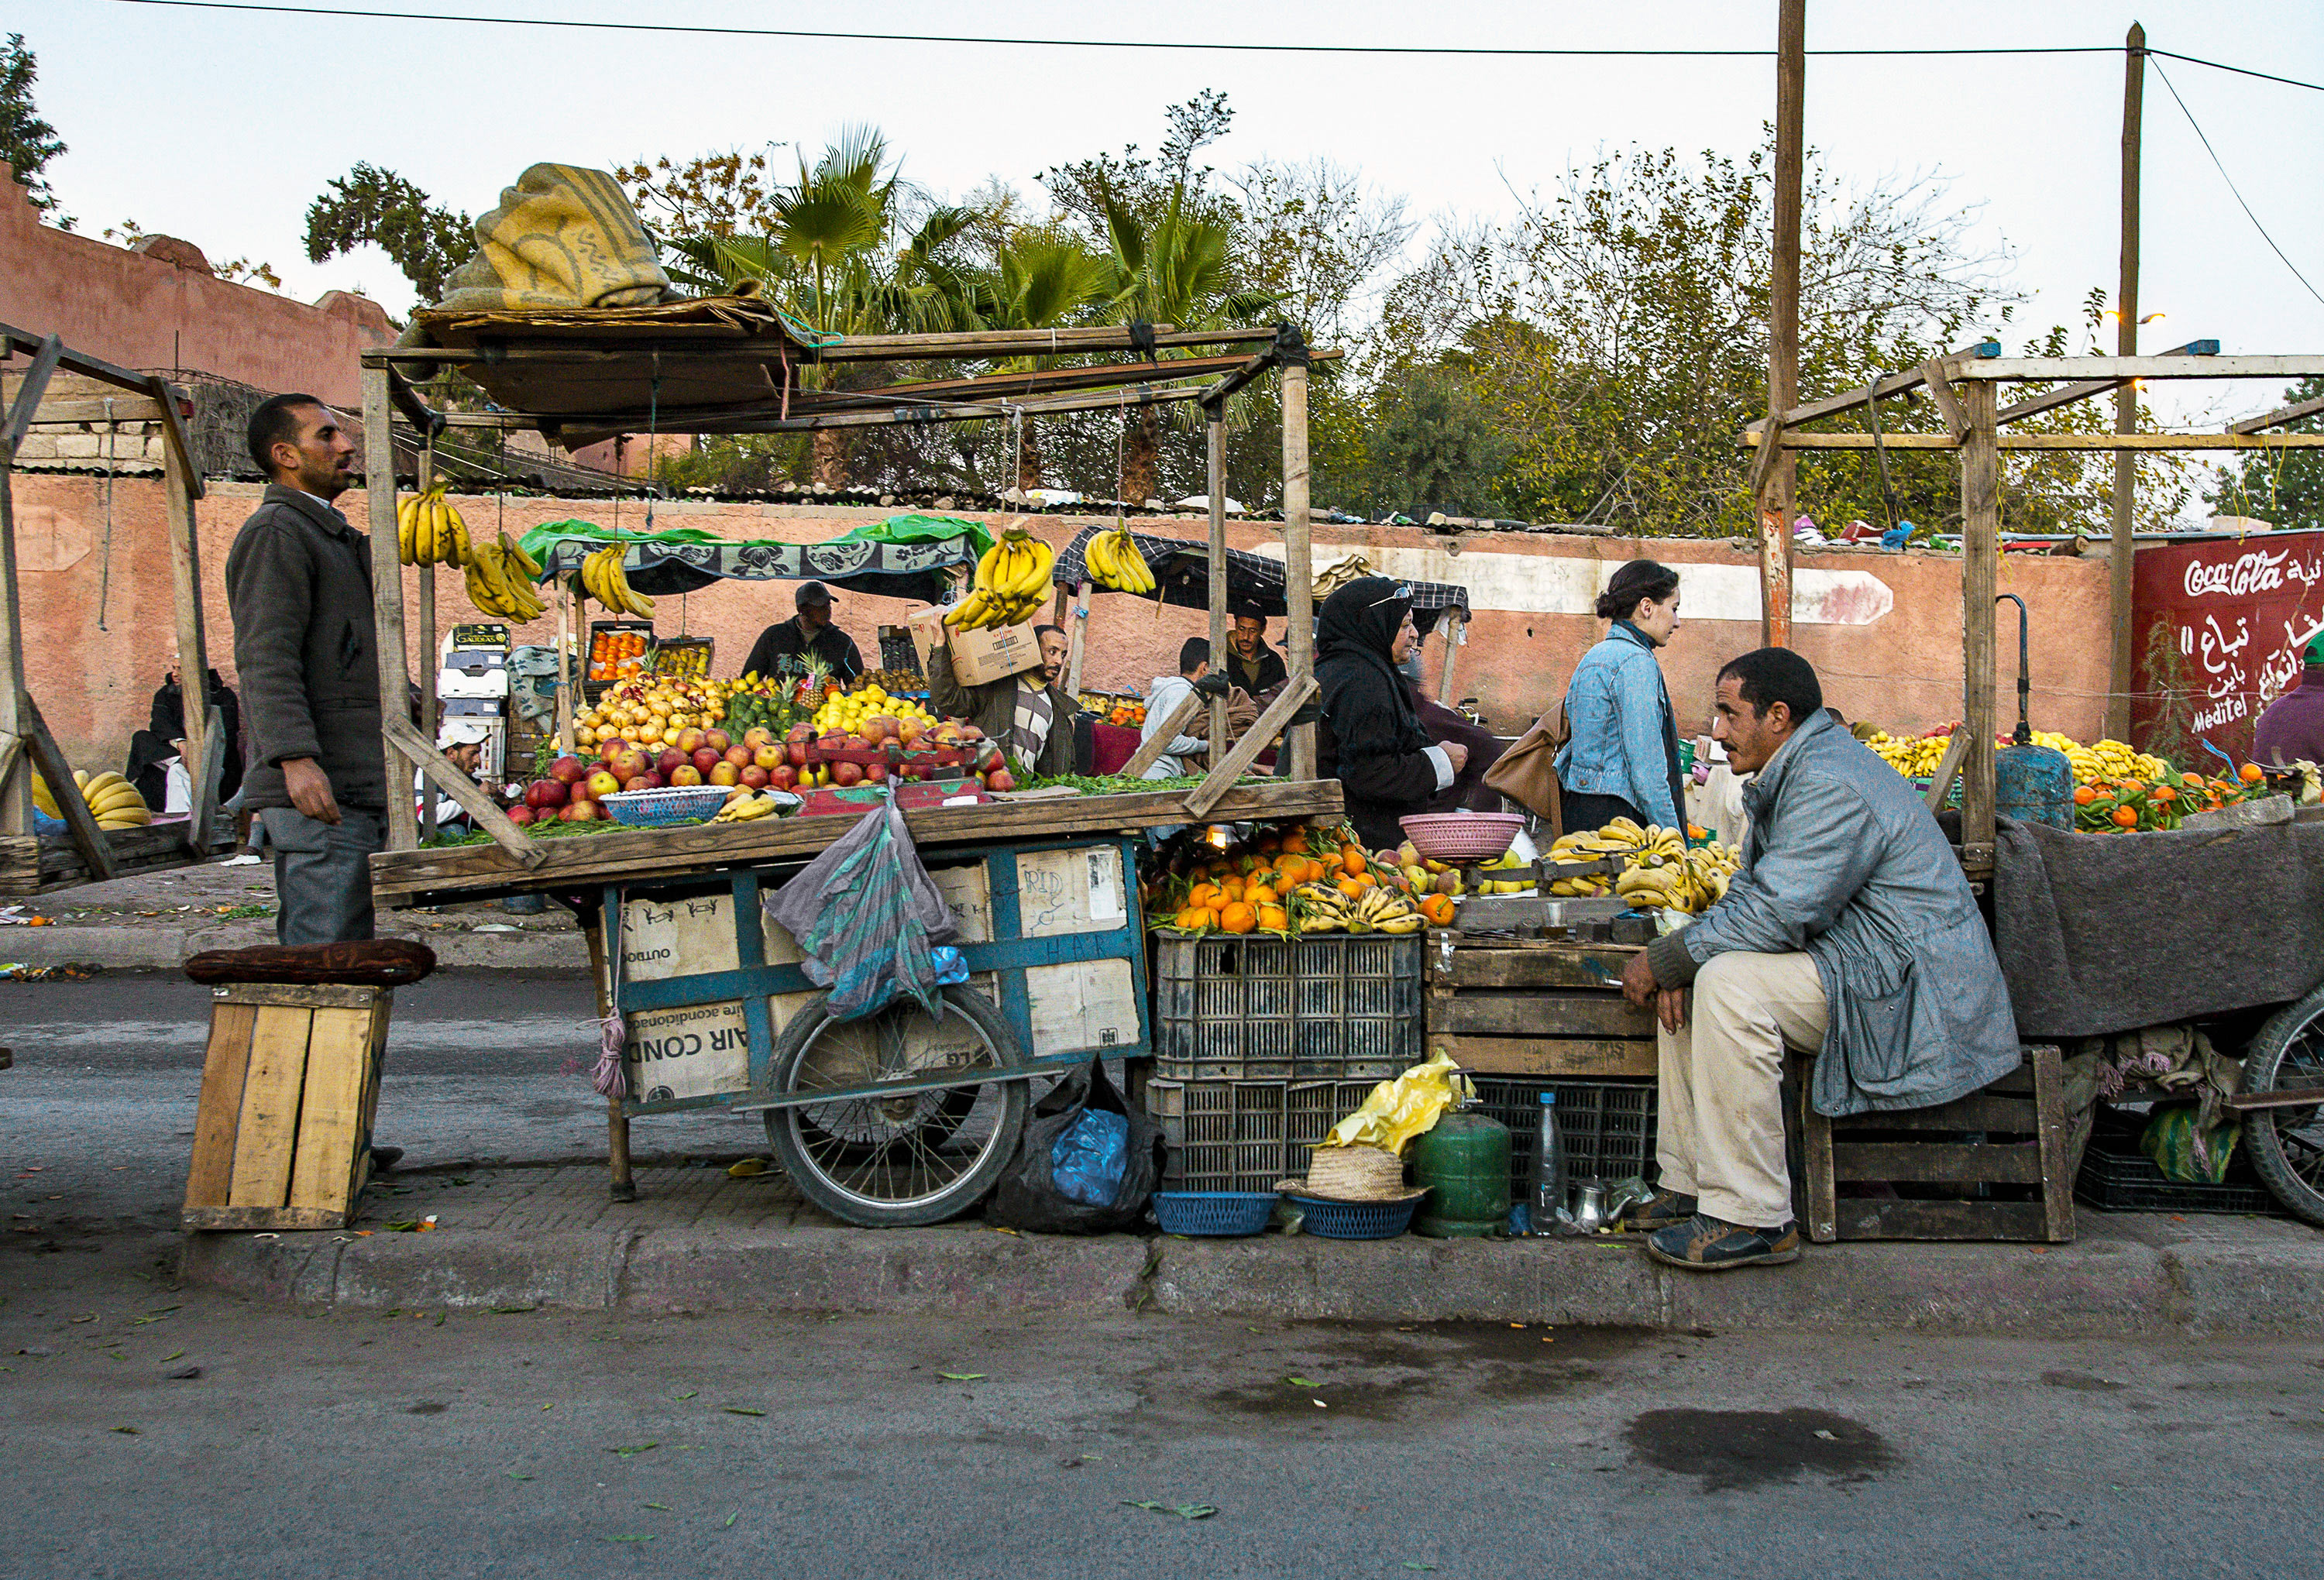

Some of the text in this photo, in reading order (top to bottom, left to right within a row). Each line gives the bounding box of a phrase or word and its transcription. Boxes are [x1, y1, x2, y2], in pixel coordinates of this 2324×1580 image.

[2185, 549, 2289, 596] Coca-Cola
[2192, 692, 2247, 733] Méditel
[709, 1026, 746, 1051] AIR
